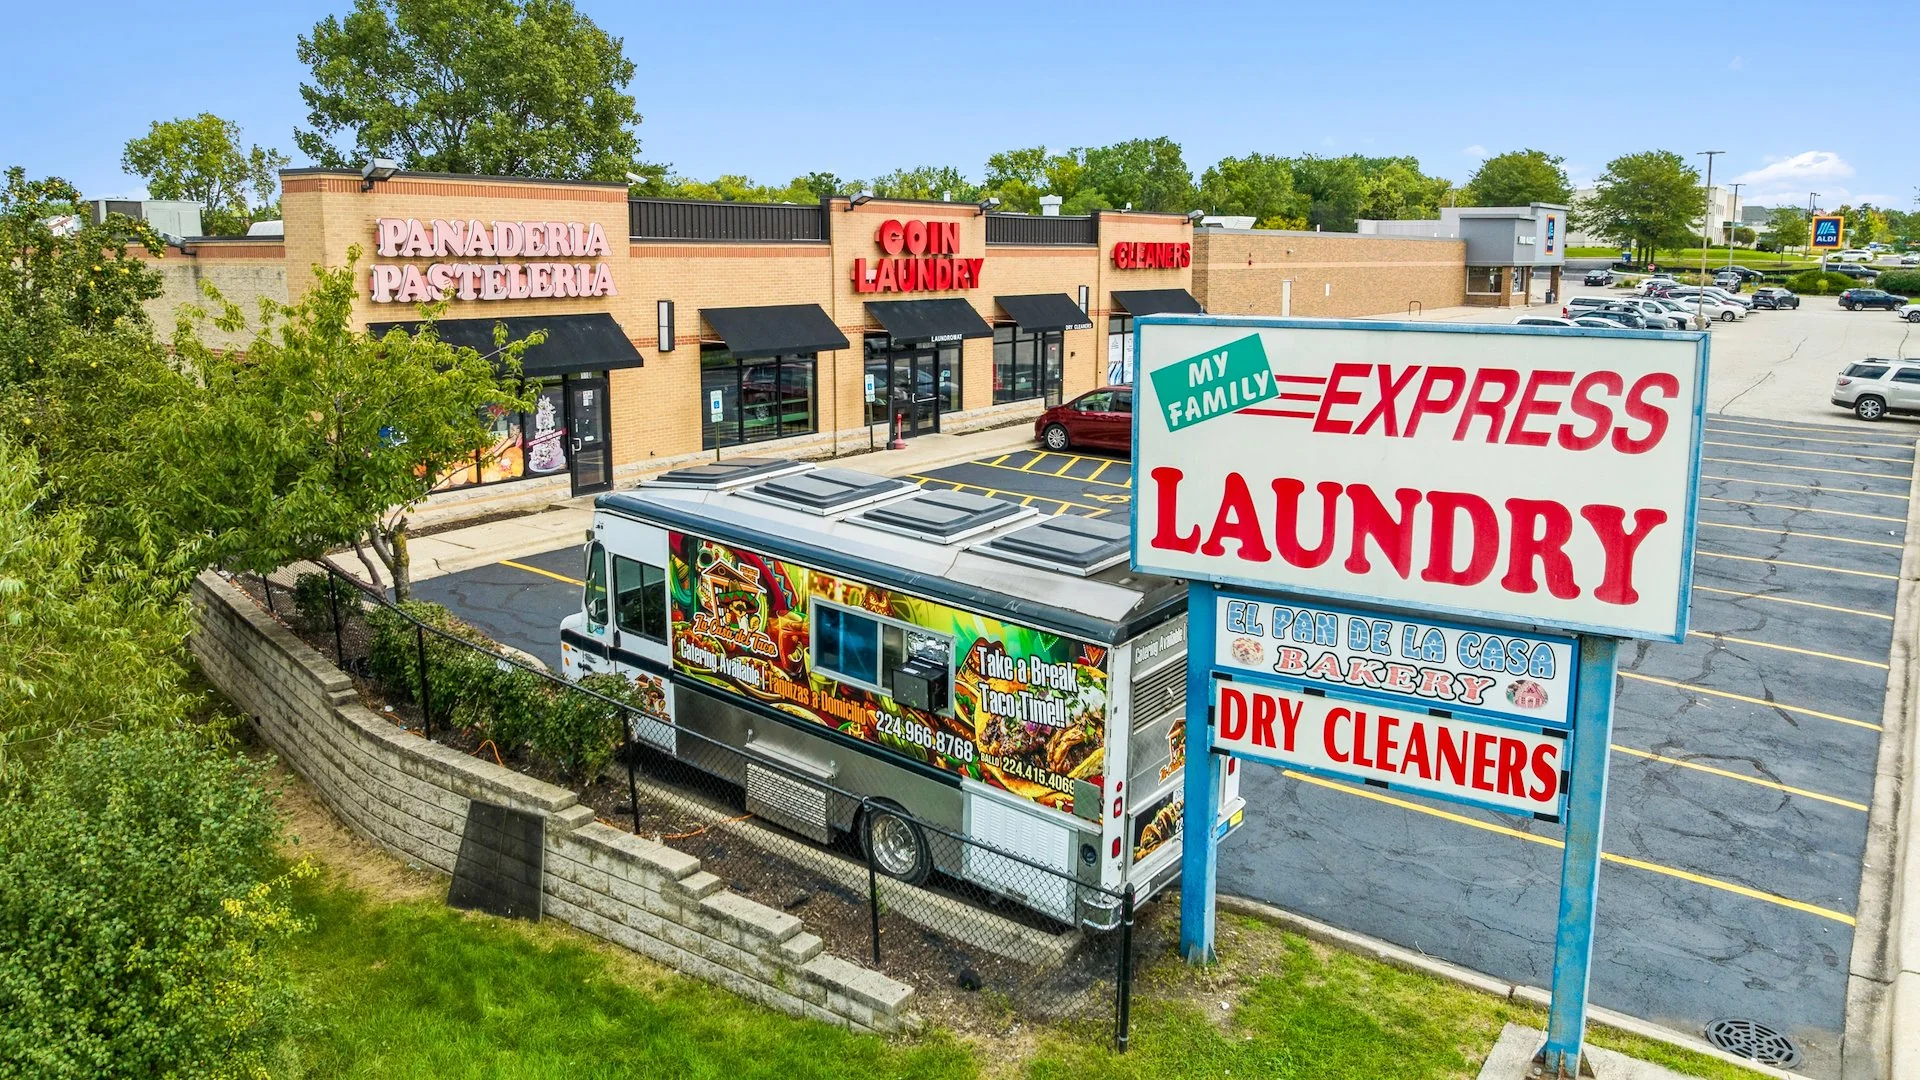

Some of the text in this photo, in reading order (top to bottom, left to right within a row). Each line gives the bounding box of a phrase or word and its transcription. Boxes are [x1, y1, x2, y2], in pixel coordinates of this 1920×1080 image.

[376, 217, 613, 258] PANADERIA
[879, 219, 960, 255] COIN
[1114, 241, 1191, 270] CLEANERS
[371, 262, 618, 303] PASTELERIA
[855, 257, 984, 293] LAUNDRY
[931, 333, 963, 342] LAUNDROMAT
[1188, 350, 1228, 388] MY
[1168, 369, 1269, 427] FAMILY
[1313, 362, 1680, 455] EXPRESS
[1150, 466, 1668, 606] LAUNDRY
[694, 613, 777, 656] La Casa del Taco
[1135, 640, 1159, 664] Catering
[1226, 600, 1556, 679] EL PAN DE LA CASA
[680, 638, 718, 673] Catering
[719, 655, 760, 687] Available
[765, 670, 810, 706] Taquizas
[812, 691, 821, 708] a
[821, 690, 867, 725] Domicilio
[977, 646, 1079, 693] Take a Break
[1273, 645, 1497, 705] BAKERY
[978, 682, 1066, 728] Taco Time!!
[875, 710, 974, 763] 224.966.8768
[1219, 687, 1557, 803] DRY CLEANERS
[1002, 756, 1075, 795] 224.415.4069
